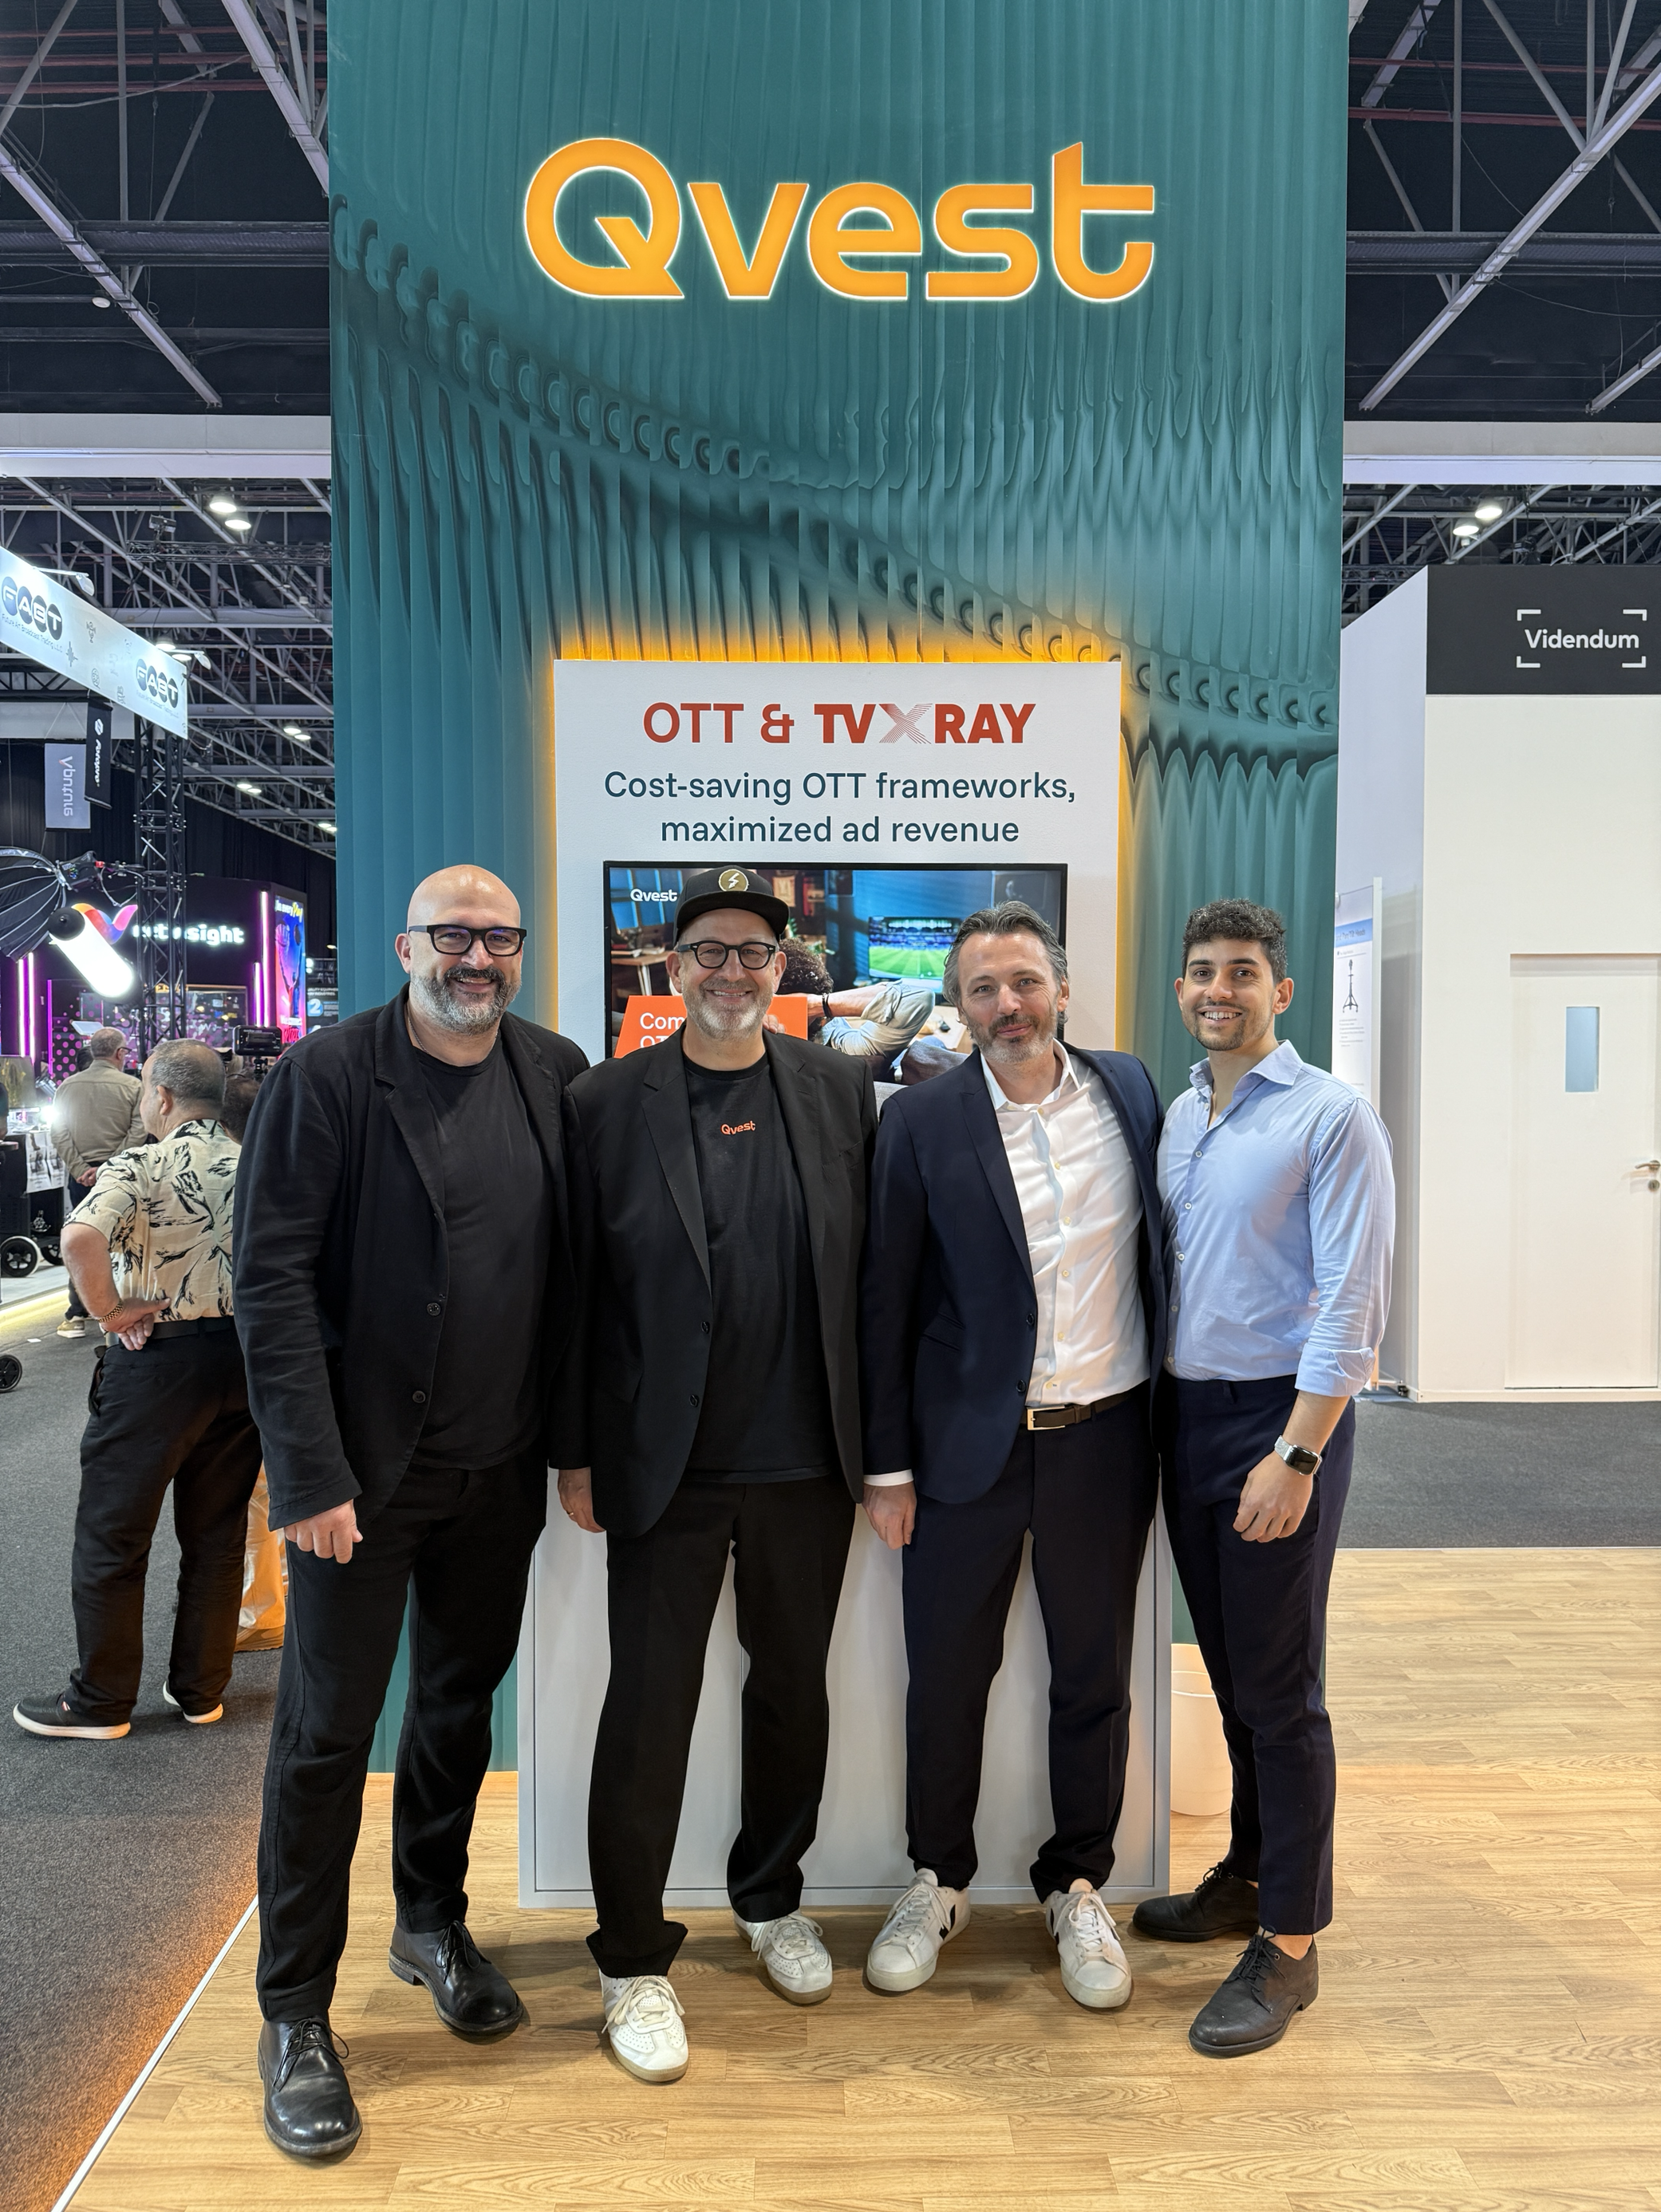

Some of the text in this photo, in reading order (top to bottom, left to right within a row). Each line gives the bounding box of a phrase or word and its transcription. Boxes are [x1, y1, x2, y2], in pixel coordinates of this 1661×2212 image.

[523, 139, 1156, 302] Qvest
[1525, 629, 1639, 649] Videndum
[644, 703, 744, 743] OTT
[760, 704, 794, 743] &
[605, 771, 1075, 806] Cost-saving OTT frameworks,
[661, 815, 1019, 842] maximized ad revenue
[630, 889, 677, 902] Qvest
[720, 1121, 756, 1135] Qvest
